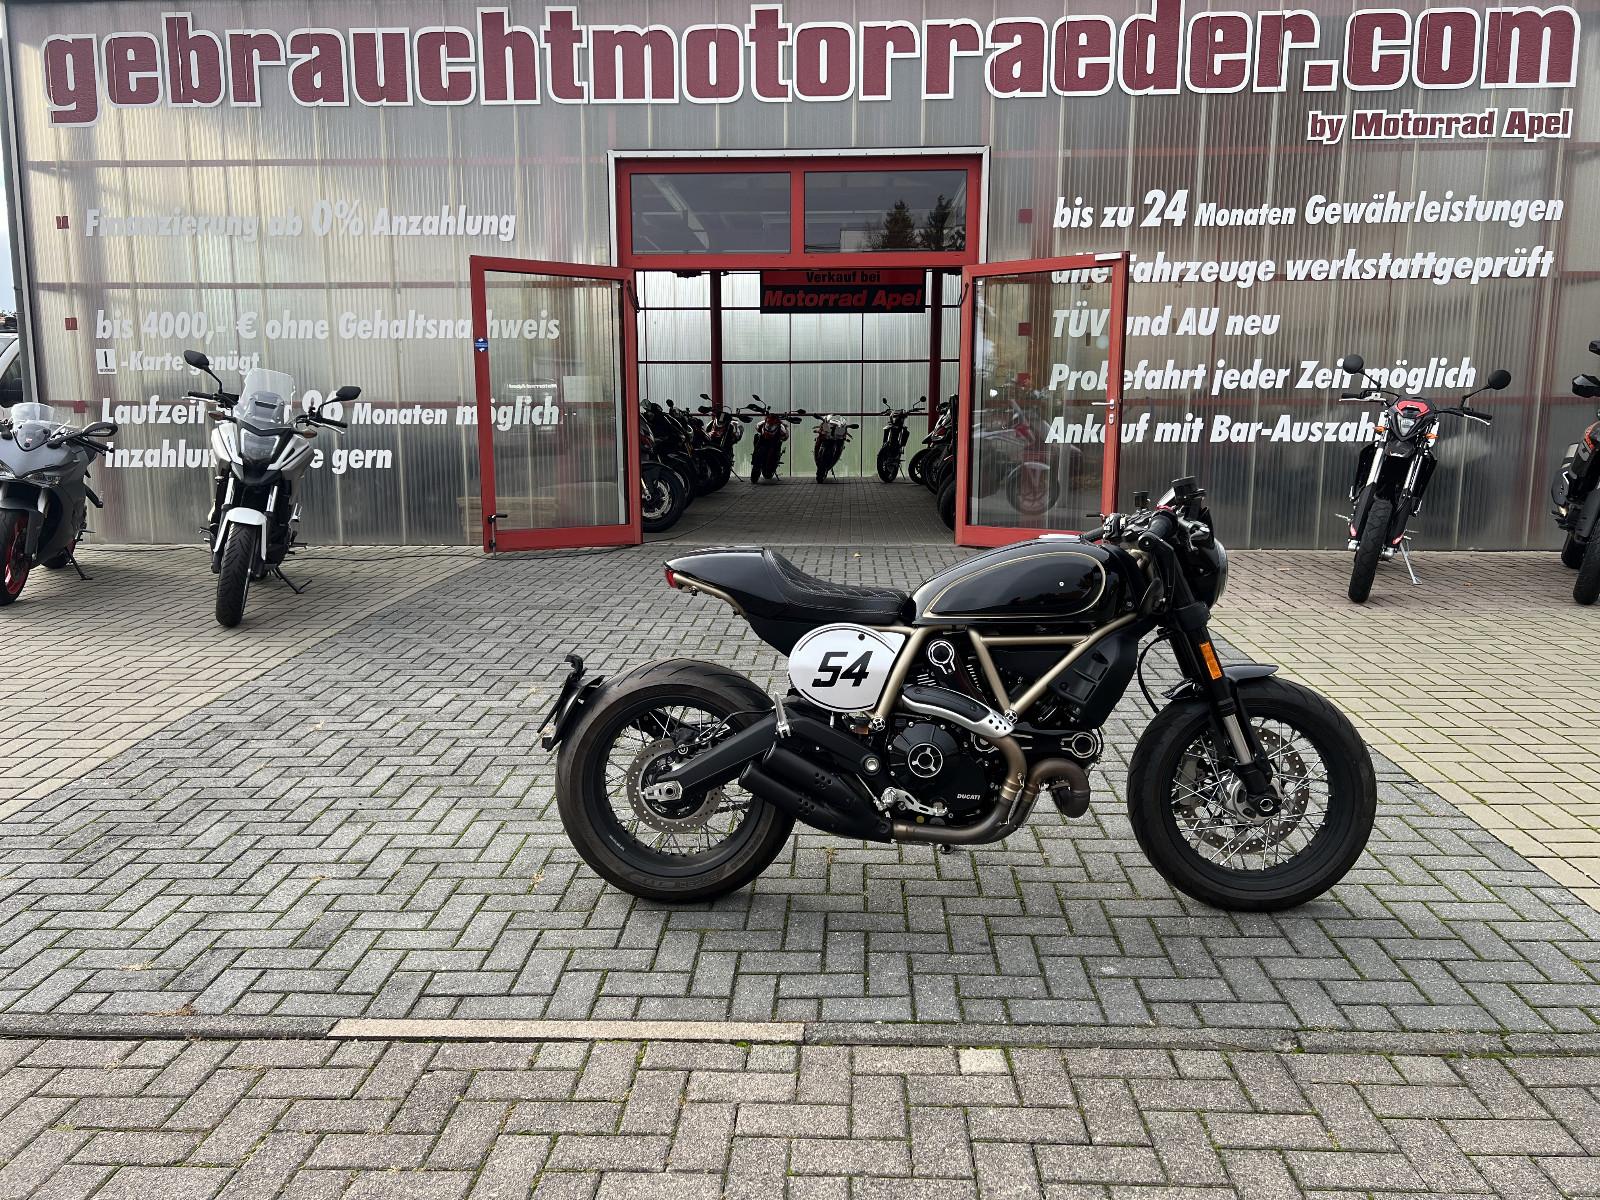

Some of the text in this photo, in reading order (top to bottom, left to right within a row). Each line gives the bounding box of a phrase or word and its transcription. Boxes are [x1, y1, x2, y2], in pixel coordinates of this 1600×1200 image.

[42, 0, 1580, 127] gebrauchtmotorraeder.com
[1307, 108, 1573, 144] by Motorrad Apel
[86, 199, 516, 242] Finanzierung ab 0% Anzahlung
[1053, 189, 1564, 228] bis zu 24 Monaten Gewährleistungen
[806, 271, 880, 283] Verkauf bei
[1286, 246, 1554, 284] werkstattgeprüft
[764, 289, 922, 309] Motorrad Apel
[96, 310, 133, 339] bis
[236, 311, 257, 339] €
[266, 310, 328, 339] ohne
[339, 309, 560, 339] Gehaltsnahweis
[1053, 301, 1280, 338] TÜV und AU neu
[1211, 359, 1290, 396] jeder
[1295, 358, 1355, 389] Zeit
[1361, 357, 1477, 395] möglich
[101, 395, 206, 424] Laufzeit
[352, 403, 447, 425] Monaten
[1154, 413, 1204, 442] mit
[332, 448, 392, 474] gern
[812, 651, 873, 687] 54
[957, 793, 981, 801] DUCATI
